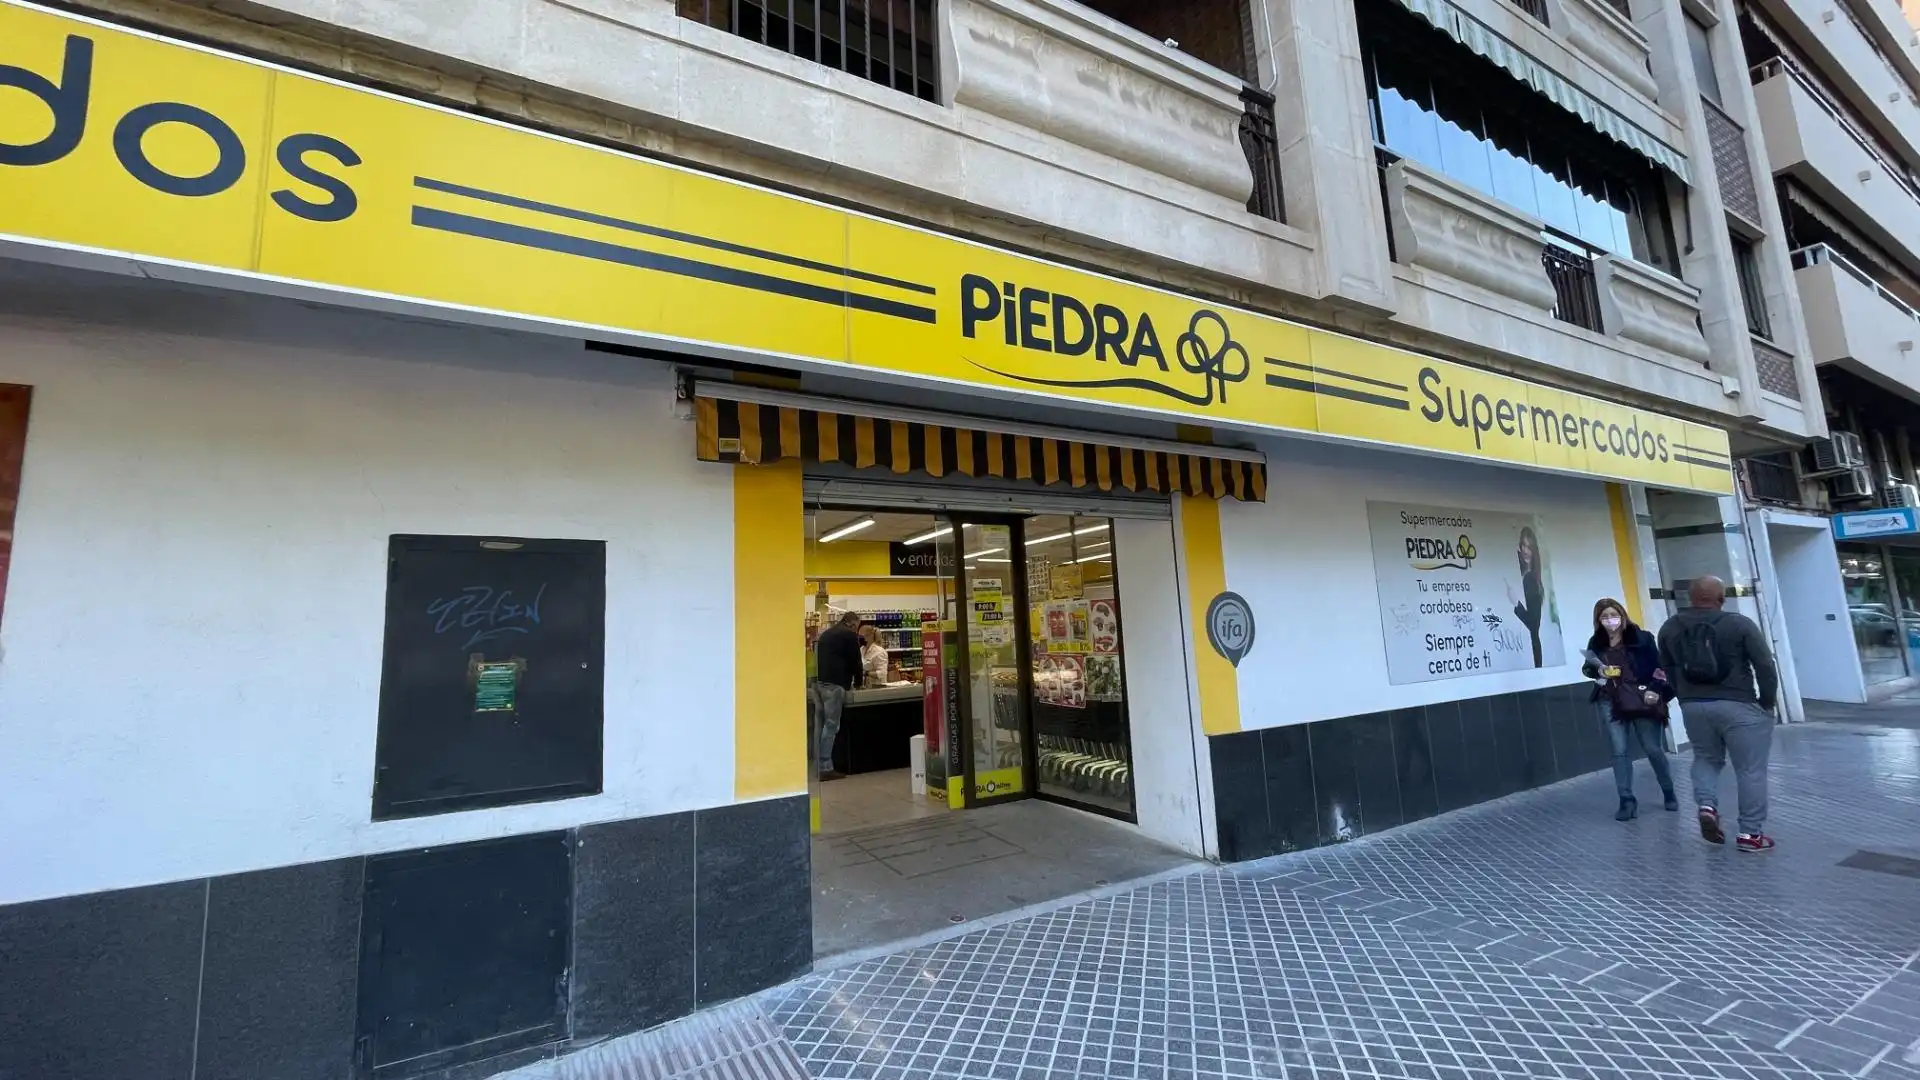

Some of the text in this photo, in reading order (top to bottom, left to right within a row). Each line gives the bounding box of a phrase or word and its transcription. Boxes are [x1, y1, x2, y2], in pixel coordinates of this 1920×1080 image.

[1418, 367, 1668, 463] Supermercados
[1400, 510, 1472, 529] Supermercados
[1416, 580, 1470, 596] Tu empresa
[1420, 598, 1473, 614] cordobesa
[1222, 619, 1242, 640] ifa
[1425, 633, 1474, 655] Siempre
[1428, 650, 1491, 674] cerca de ti
